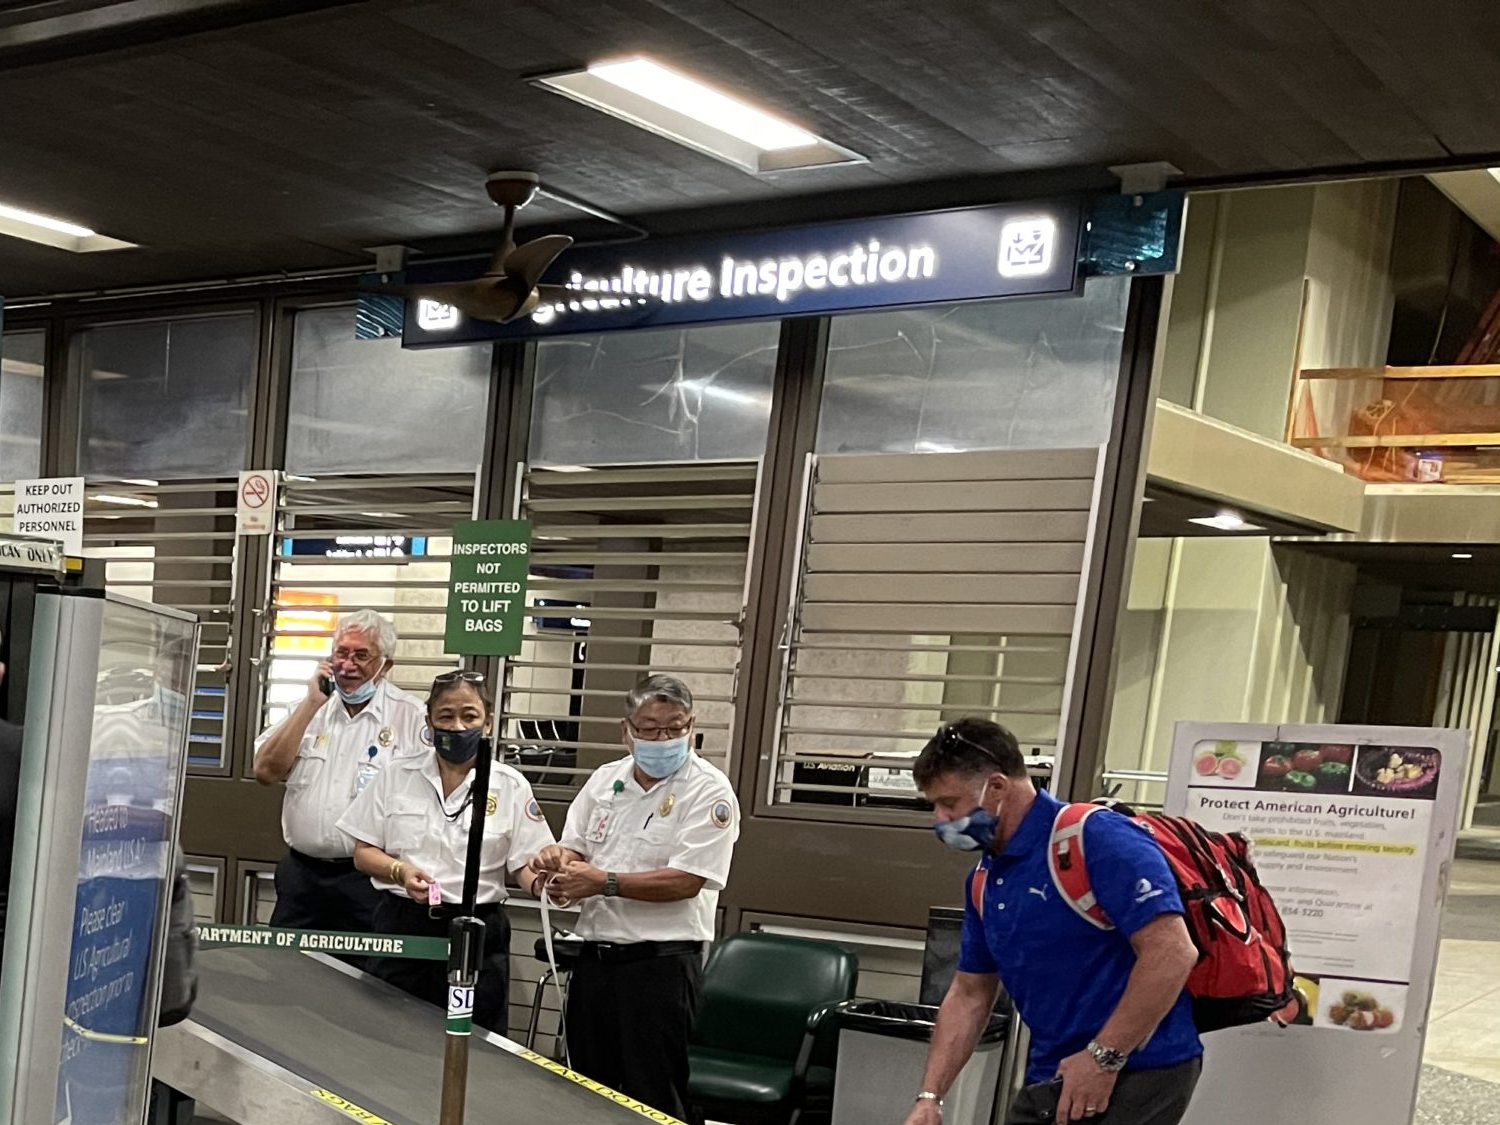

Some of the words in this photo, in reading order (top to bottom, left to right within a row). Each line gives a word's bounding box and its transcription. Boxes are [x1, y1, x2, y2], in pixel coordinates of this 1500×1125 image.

[719, 236, 937, 302] Inspection
[25, 485, 49, 496] KEEP
[52, 483, 74, 495] OUT
[17, 502, 81, 514] AUTHORIZED
[19, 521, 77, 532] PERSONNEL
[453, 543, 528, 555] INSPECTORS
[476, 562, 502, 574] NOT
[454, 582, 521, 594] PERMITTED
[461, 599, 479, 613] TO
[482, 599, 512, 613] LIFT
[465, 618, 503, 632] BAGS
[1199, 797, 1250, 810] Protect
[1254, 799, 1323, 814] American
[1327, 803, 1416, 819] Agriculture!
[79, 906, 105, 937] Please
[195, 927, 272, 945] PARTMENT
[276, 932, 295, 947] OF
[300, 934, 403, 953] AGRICULTURE
[520, 1049, 593, 1088] PLEASE
[597, 1086, 630, 1104] DO
[632, 1103, 681, 1125] NOT
[317, 1089, 374, 1121] BAGS
